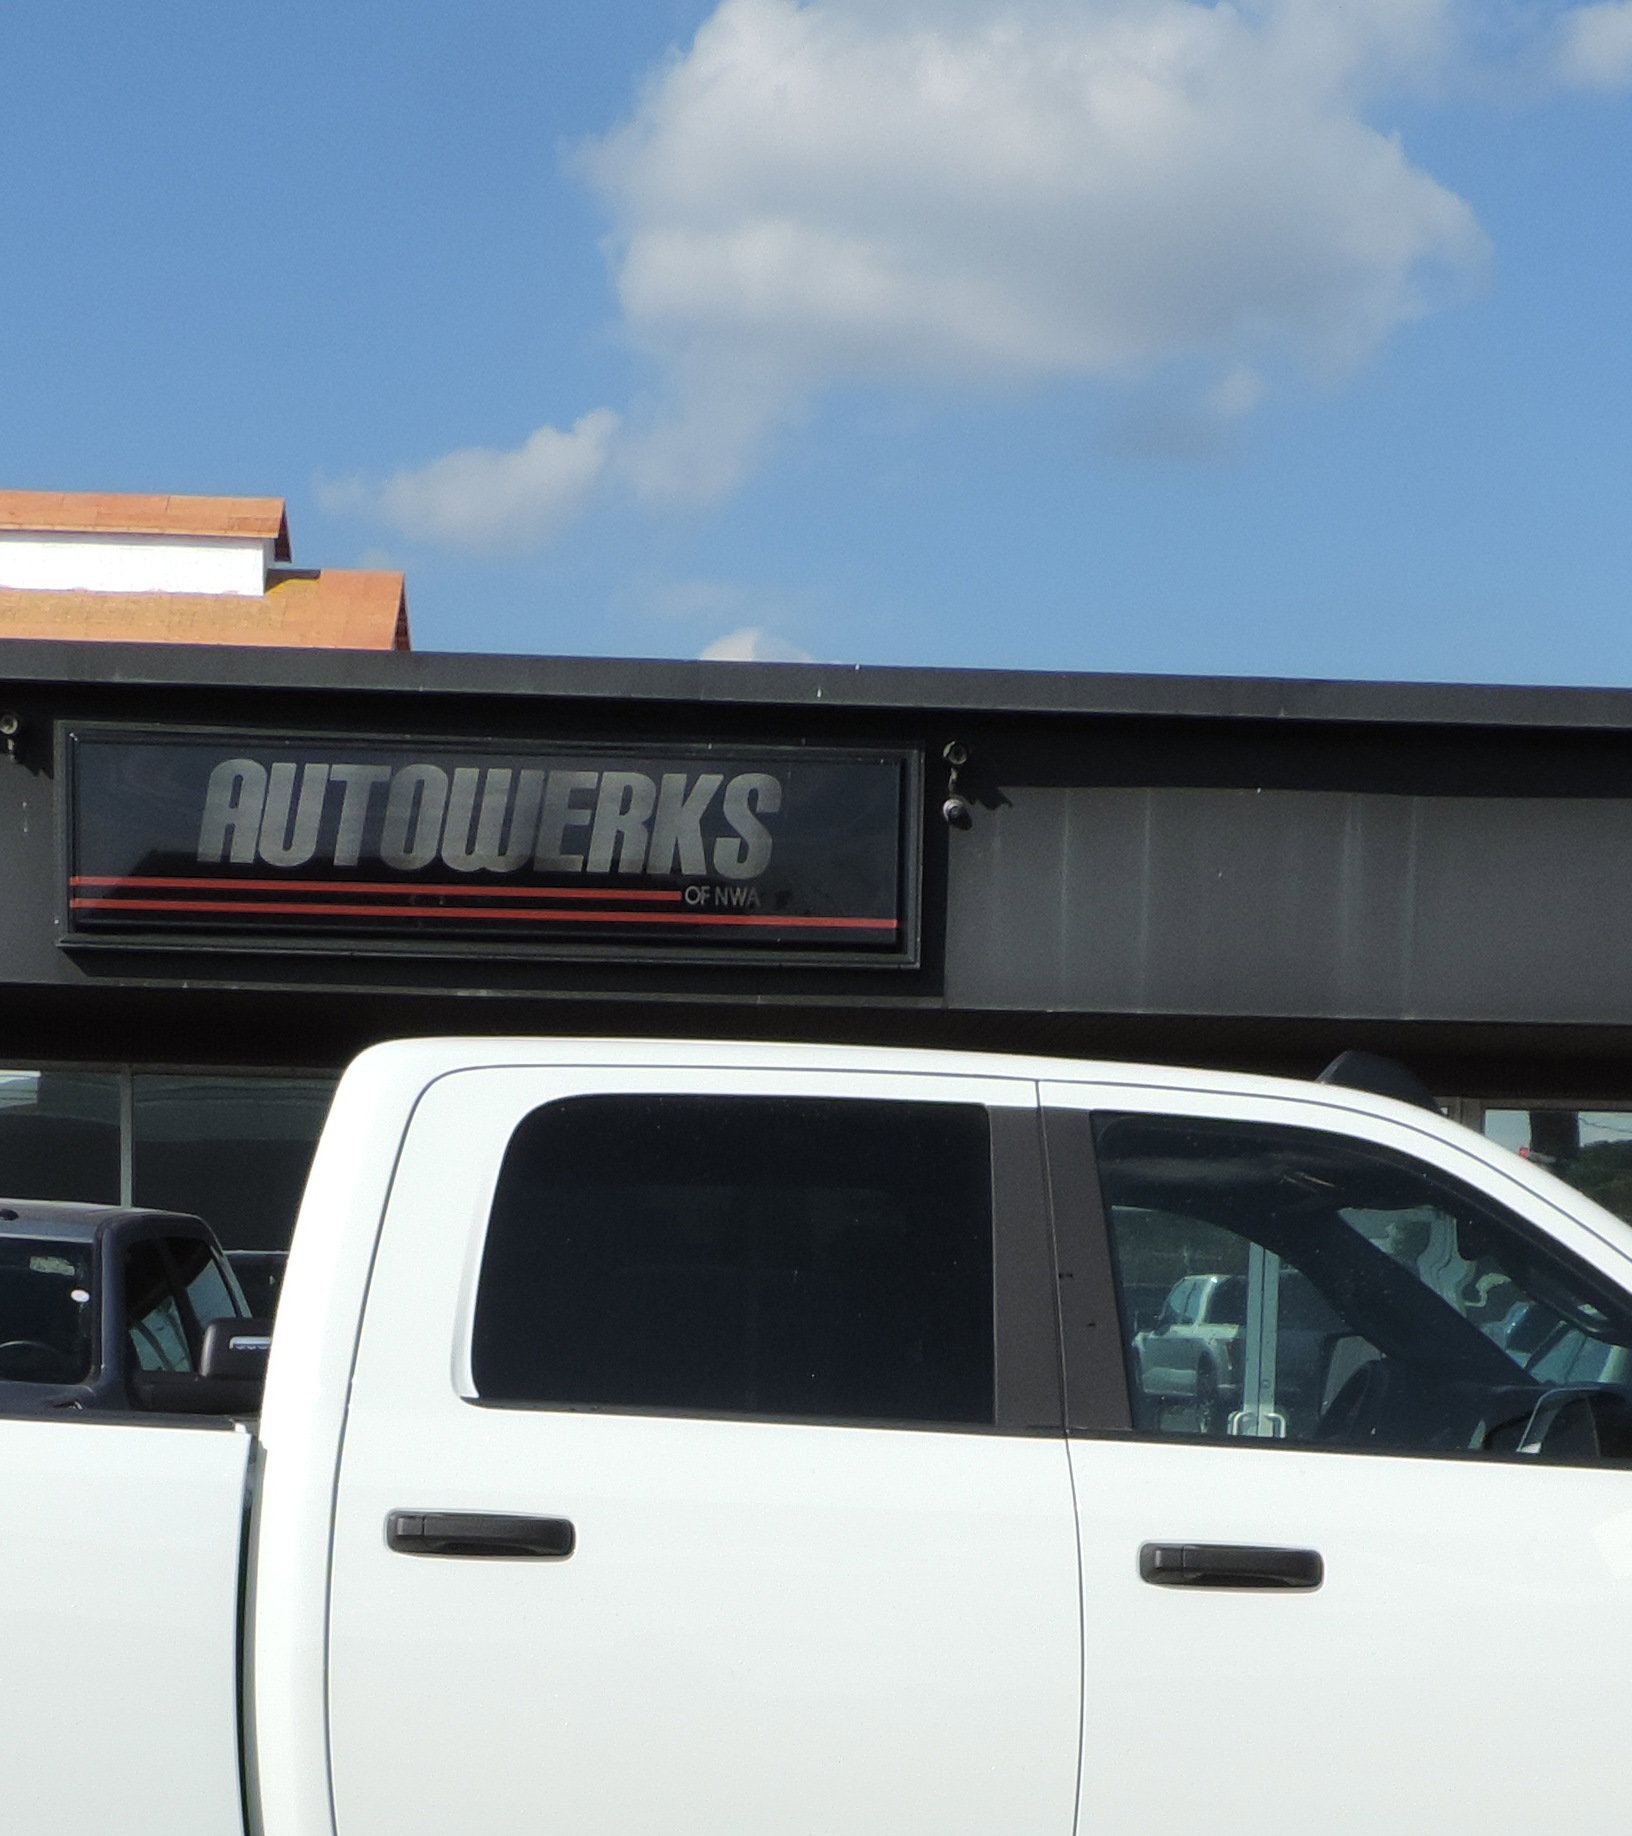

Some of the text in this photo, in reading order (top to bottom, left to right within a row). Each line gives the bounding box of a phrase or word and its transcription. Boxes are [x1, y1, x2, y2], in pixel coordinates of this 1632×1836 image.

[197, 758, 783, 880] AUTOWERKS
[685, 886, 762, 907] OF NWA
